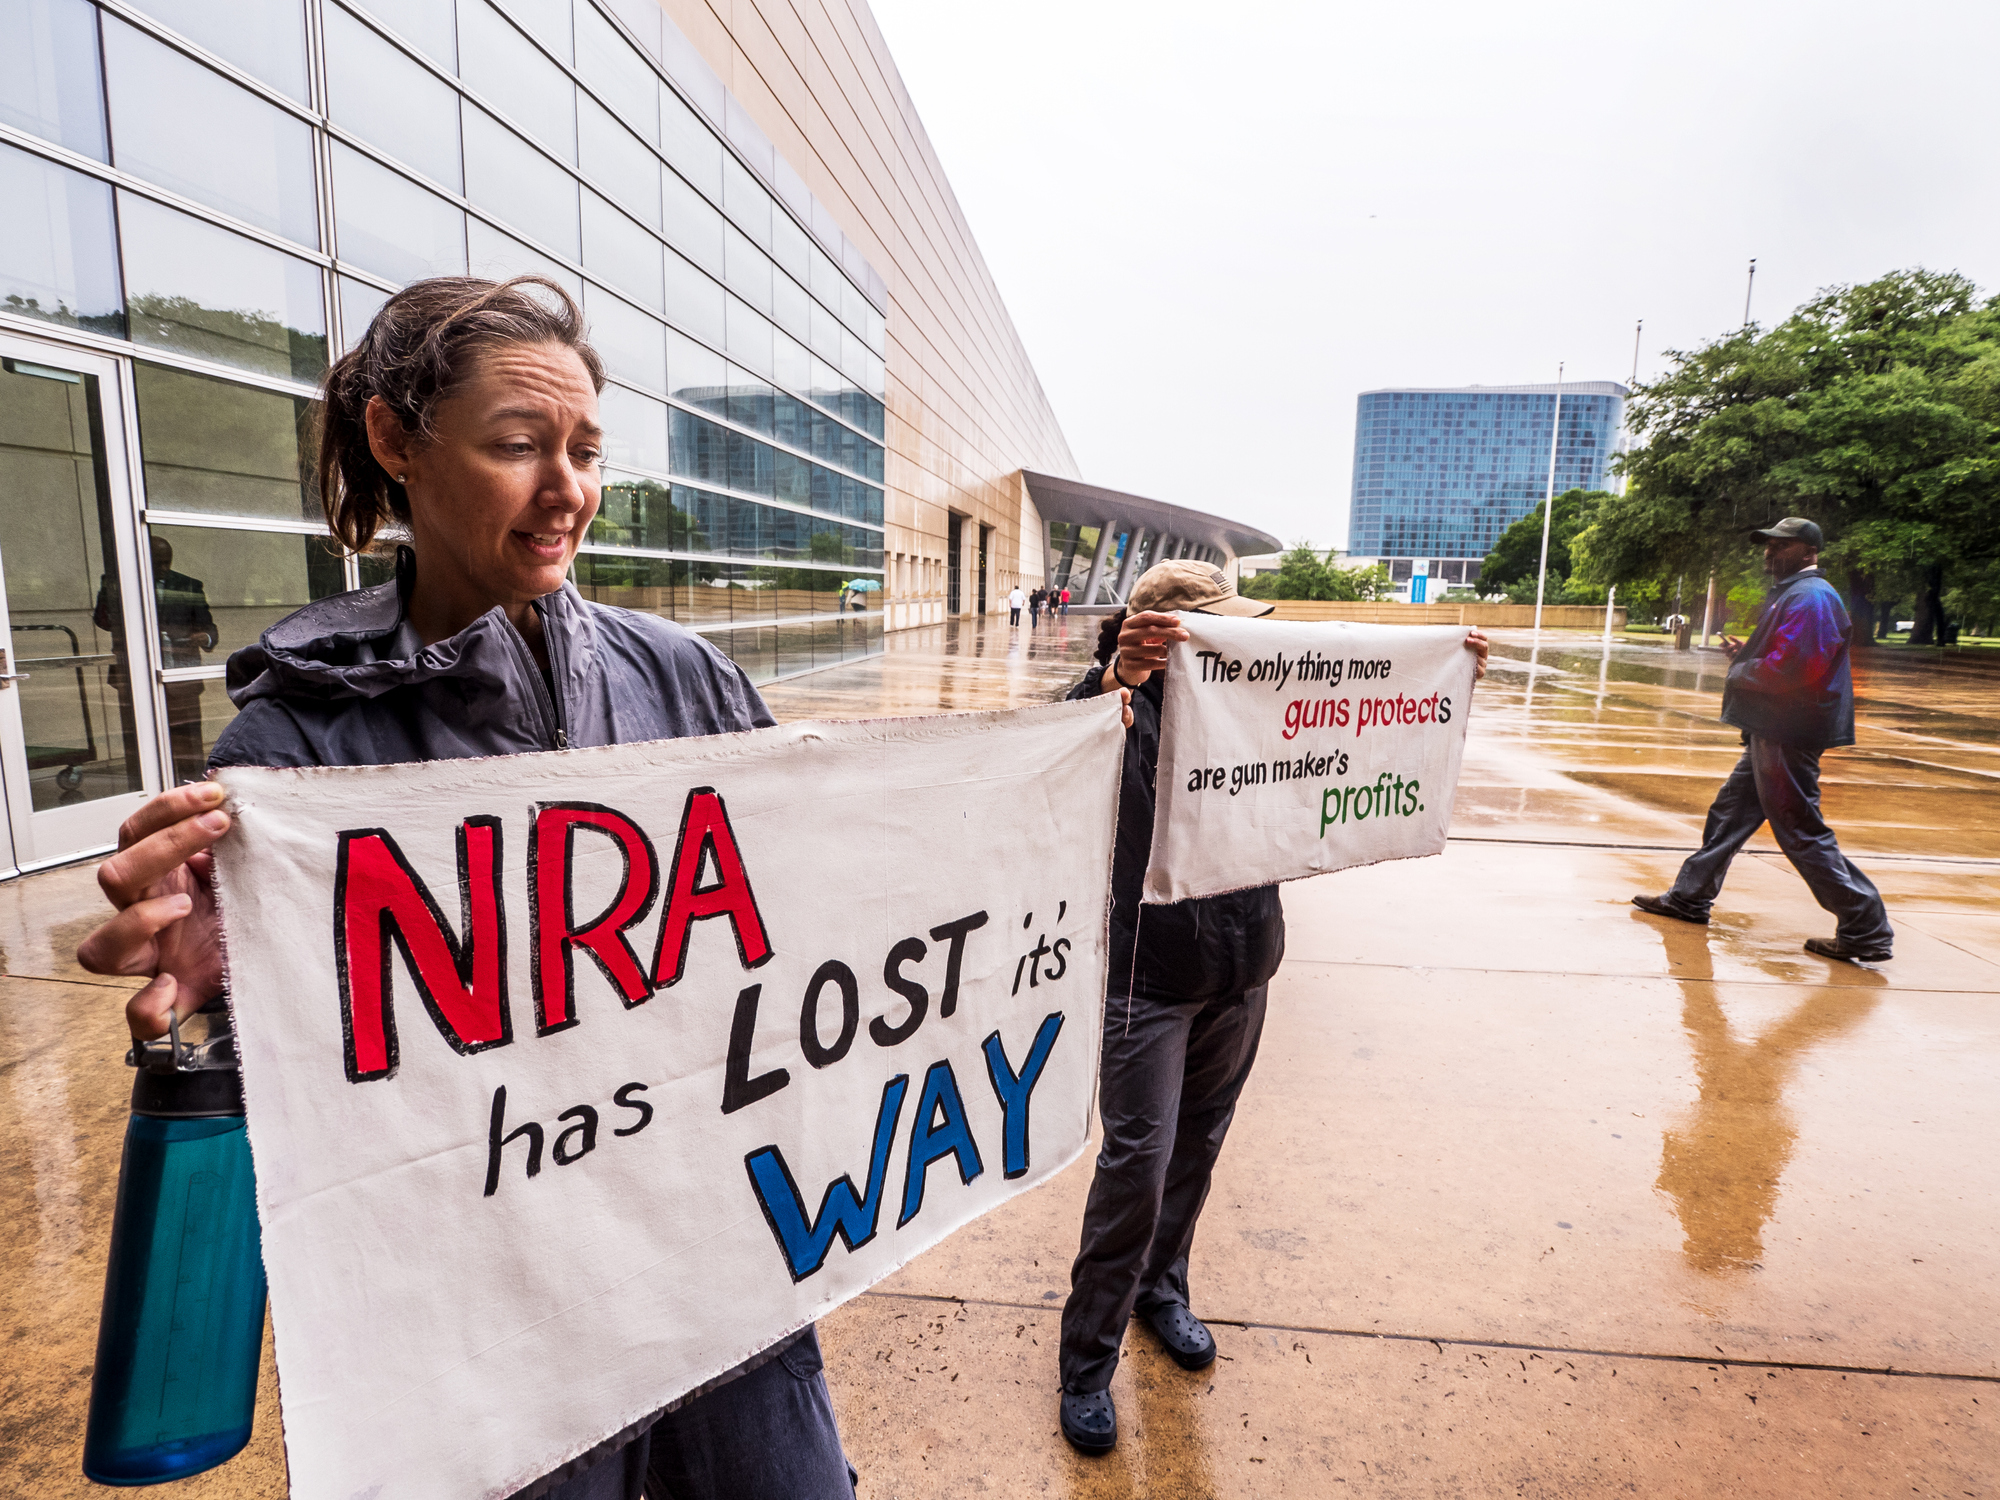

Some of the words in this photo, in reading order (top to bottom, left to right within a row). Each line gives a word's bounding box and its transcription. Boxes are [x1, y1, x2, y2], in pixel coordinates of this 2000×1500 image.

[1195, 650, 1243, 683] The
[1246, 651, 1294, 692] only
[1296, 650, 1344, 688] thing
[1347, 658, 1392, 680] more
[1281, 698, 1350, 740] guns
[1356, 691, 1452, 738] protects
[1187, 767, 1226, 793] are
[1229, 762, 1267, 797] gun
[1272, 748, 1349, 784] maker's
[1319, 772, 1425, 840] profits.
[333, 785, 776, 1085] NRA
[483, 1081, 654, 1198] has
[720, 909, 990, 1115] LOST
[1011, 900, 1072, 997] it's
[743, 1010, 1066, 1286] WAY
